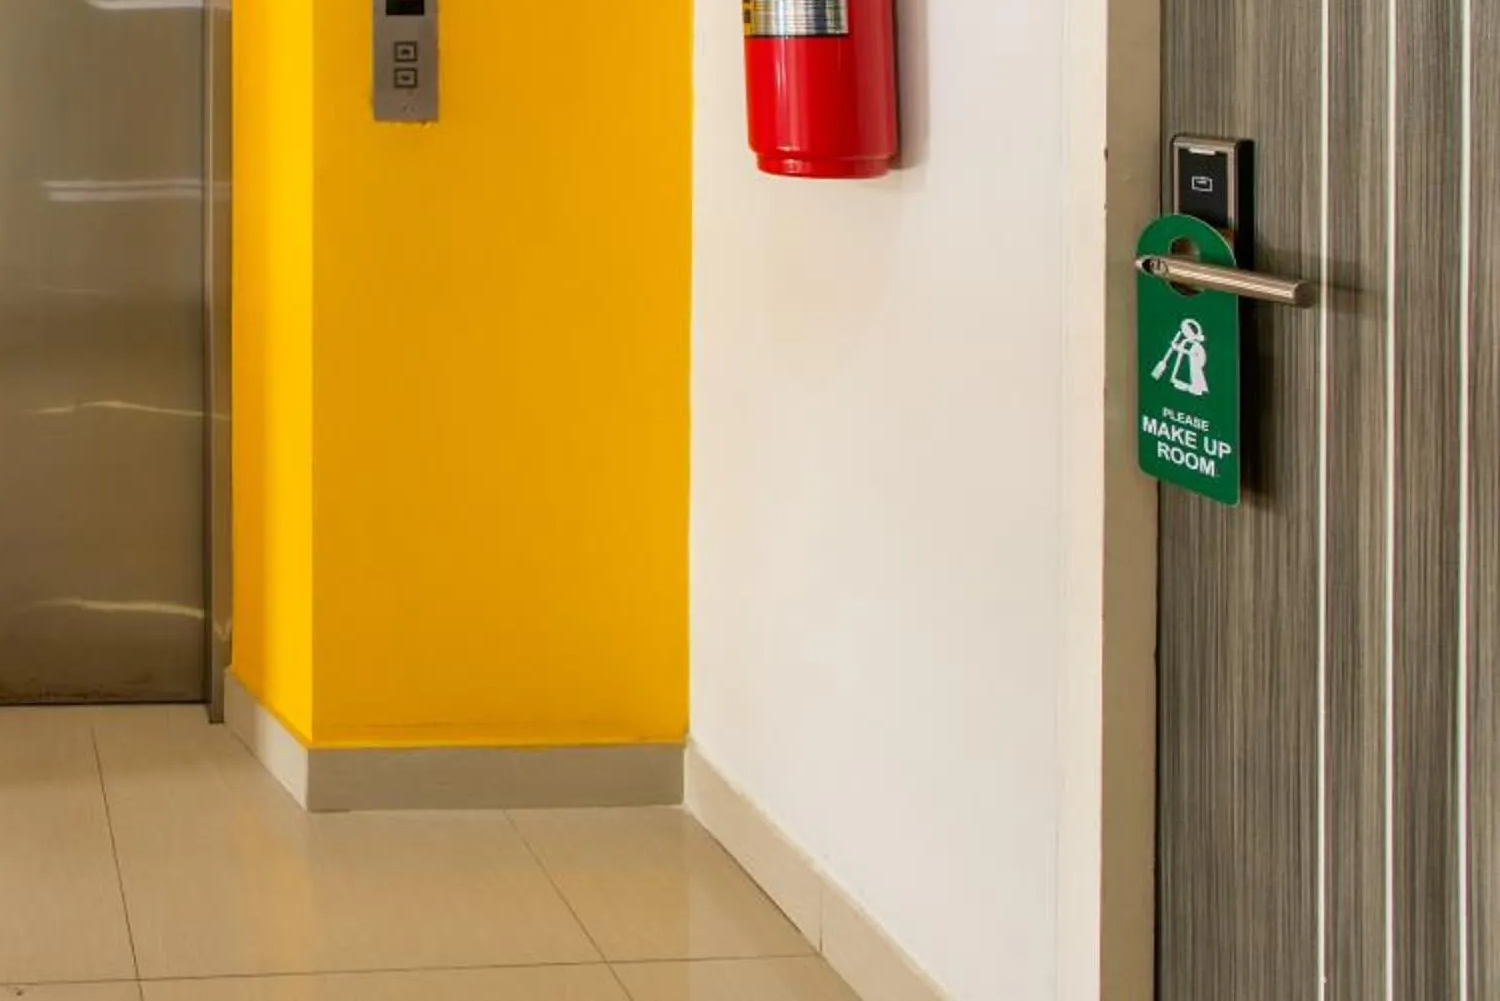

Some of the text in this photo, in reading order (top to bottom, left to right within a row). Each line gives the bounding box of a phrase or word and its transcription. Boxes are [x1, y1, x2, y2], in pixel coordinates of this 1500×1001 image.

[1141, 414, 1232, 460] MAKE UP
[1162, 406, 1210, 433] PLEASE
[1156, 440, 1216, 478] ROOM
